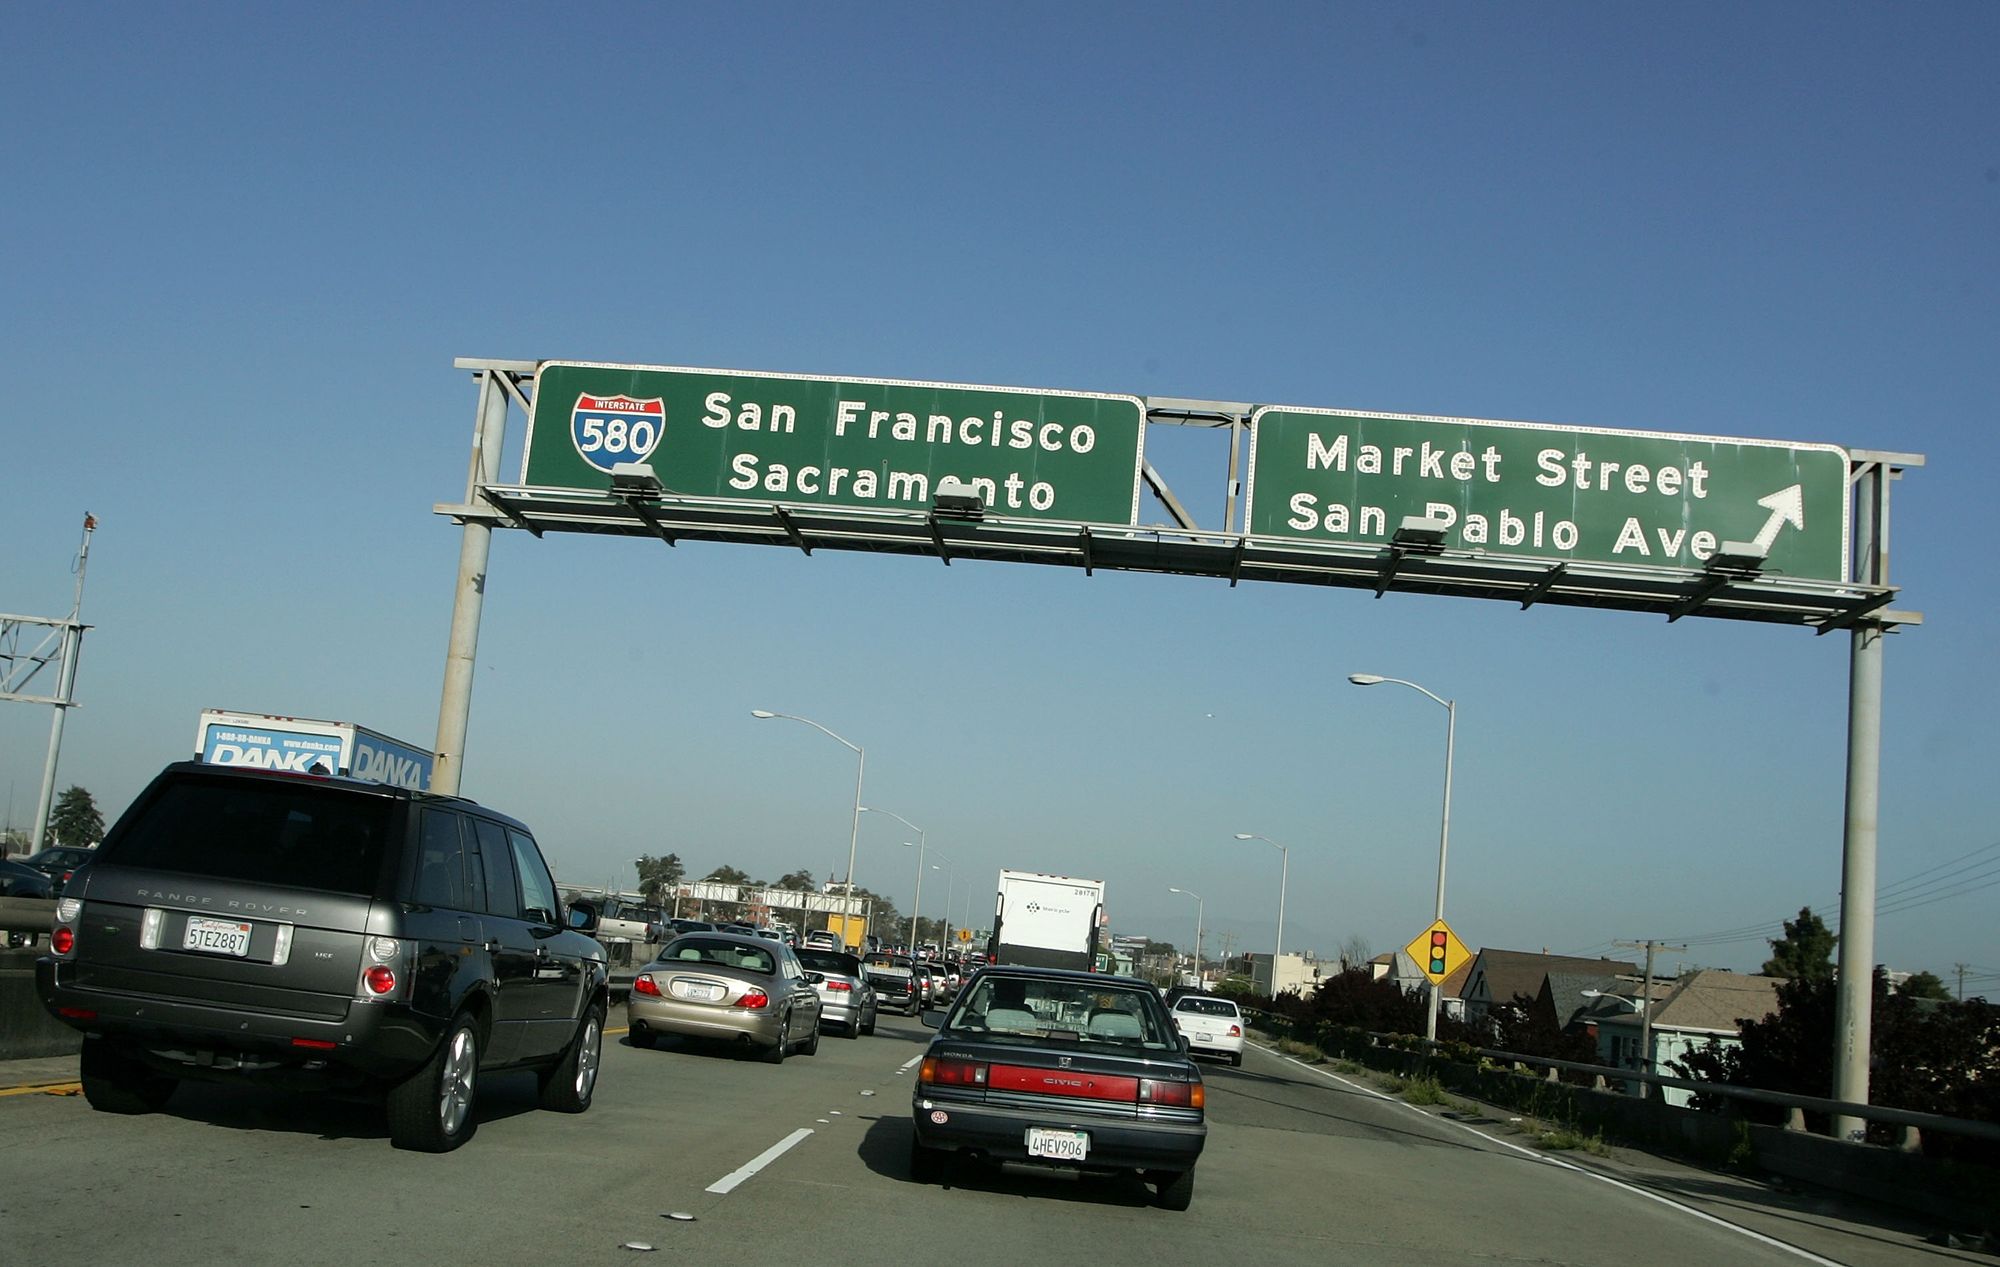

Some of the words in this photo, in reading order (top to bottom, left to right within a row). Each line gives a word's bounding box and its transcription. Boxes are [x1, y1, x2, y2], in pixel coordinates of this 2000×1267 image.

[594, 400, 646, 412] INTERSTATE
[581, 418, 655, 455] 580
[701, 392, 796, 433] San
[835, 400, 1096, 454] Francisco
[1306, 432, 1502, 483] Market
[1535, 448, 1709, 499] Street
[1287, 492, 1386, 536] San
[1612, 517, 1717, 561] Ave
[210, 743, 334, 776] DANKA
[353, 743, 421, 789] DANKA
[137, 889, 212, 905] RANGE
[228, 900, 308, 916] ROVER
[189, 929, 246, 951] 5TEZ887
[943, 1051, 974, 1059] HONDA
[1043, 1077, 1082, 1087] CIVIC
[1032, 1136, 1083, 1156] 4HEV906
